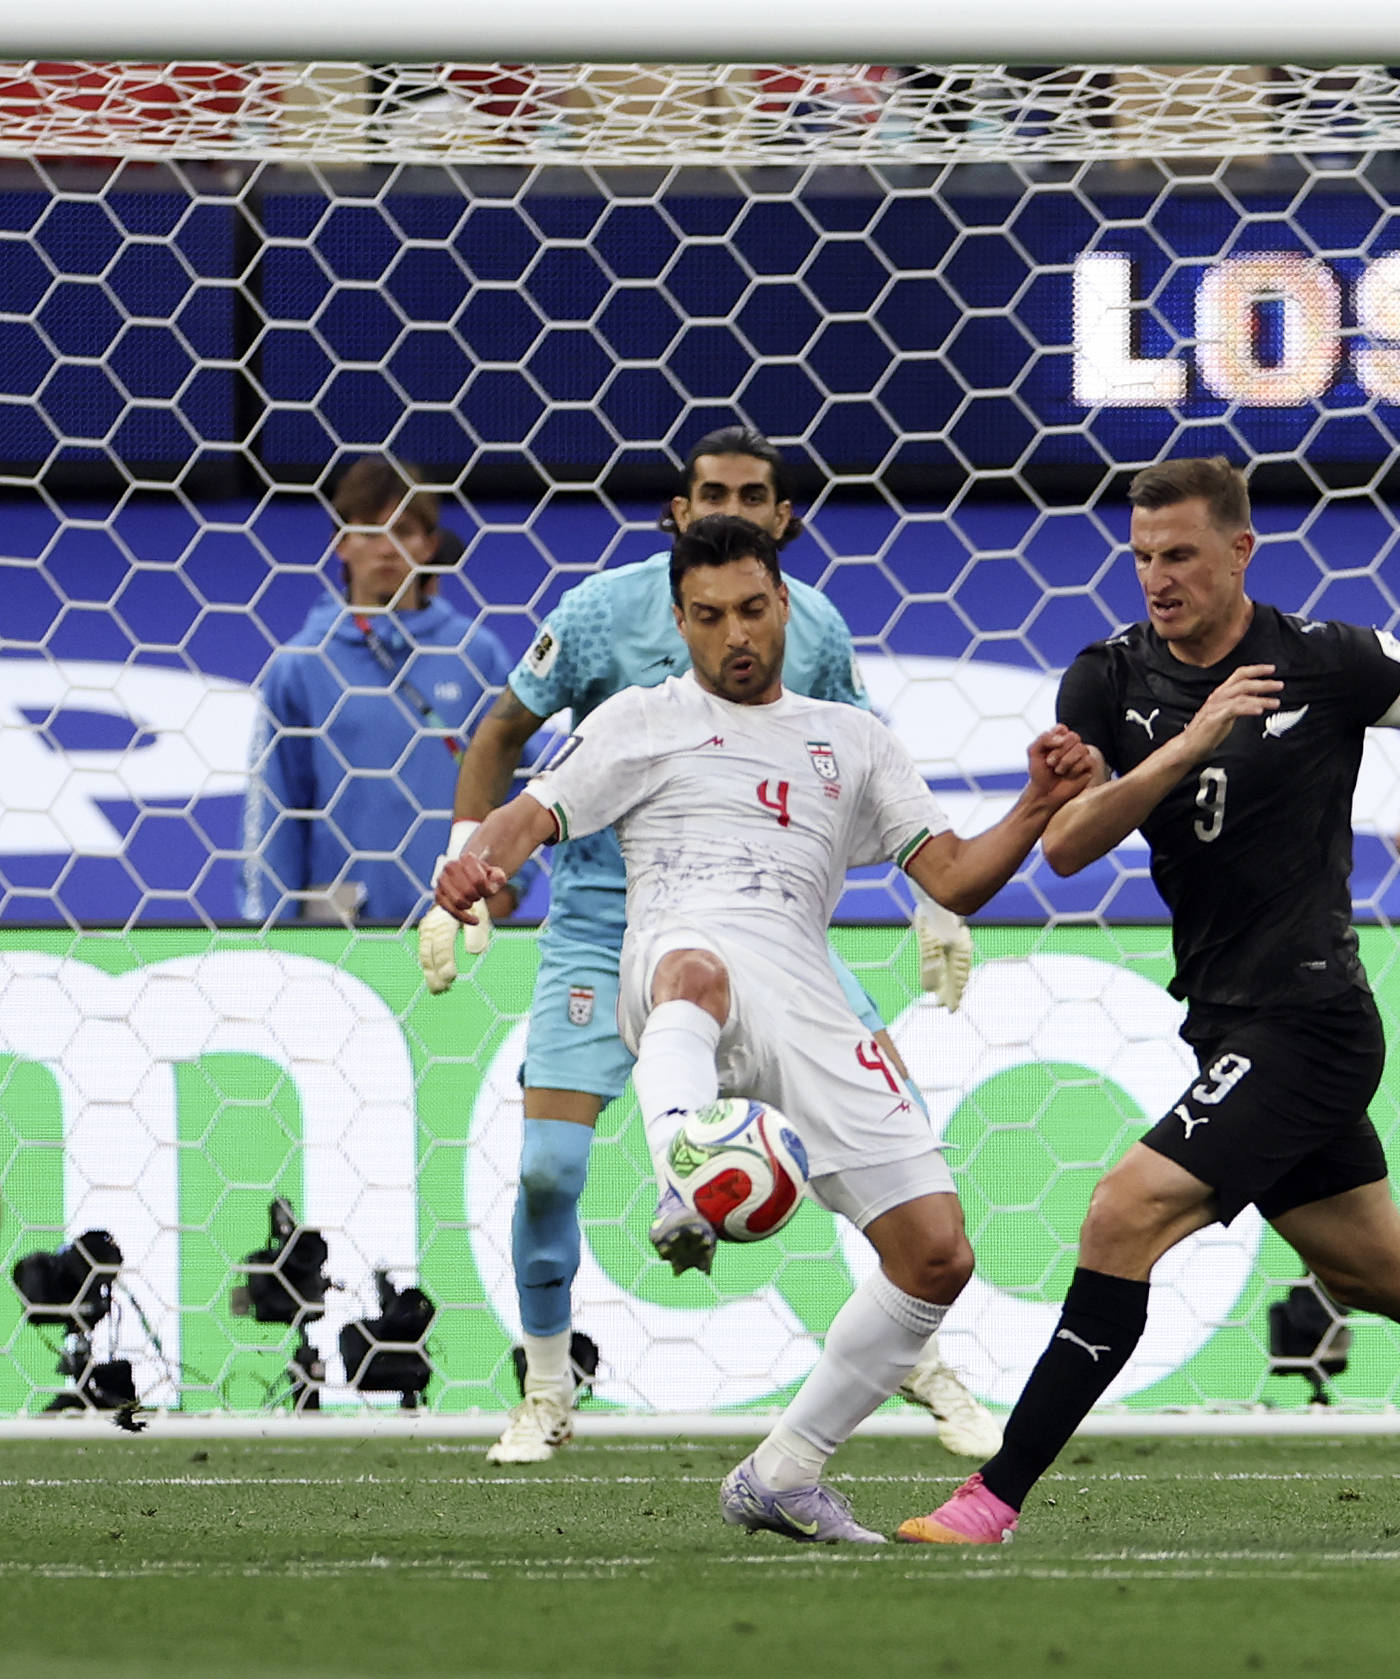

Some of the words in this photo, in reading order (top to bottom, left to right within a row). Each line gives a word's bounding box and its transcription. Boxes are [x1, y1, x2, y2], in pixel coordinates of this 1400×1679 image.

[756, 779, 790, 828] 4
[1194, 767, 1227, 843] 9
[855, 1039, 900, 1094] 4
[1191, 1052, 1252, 1105] 9
